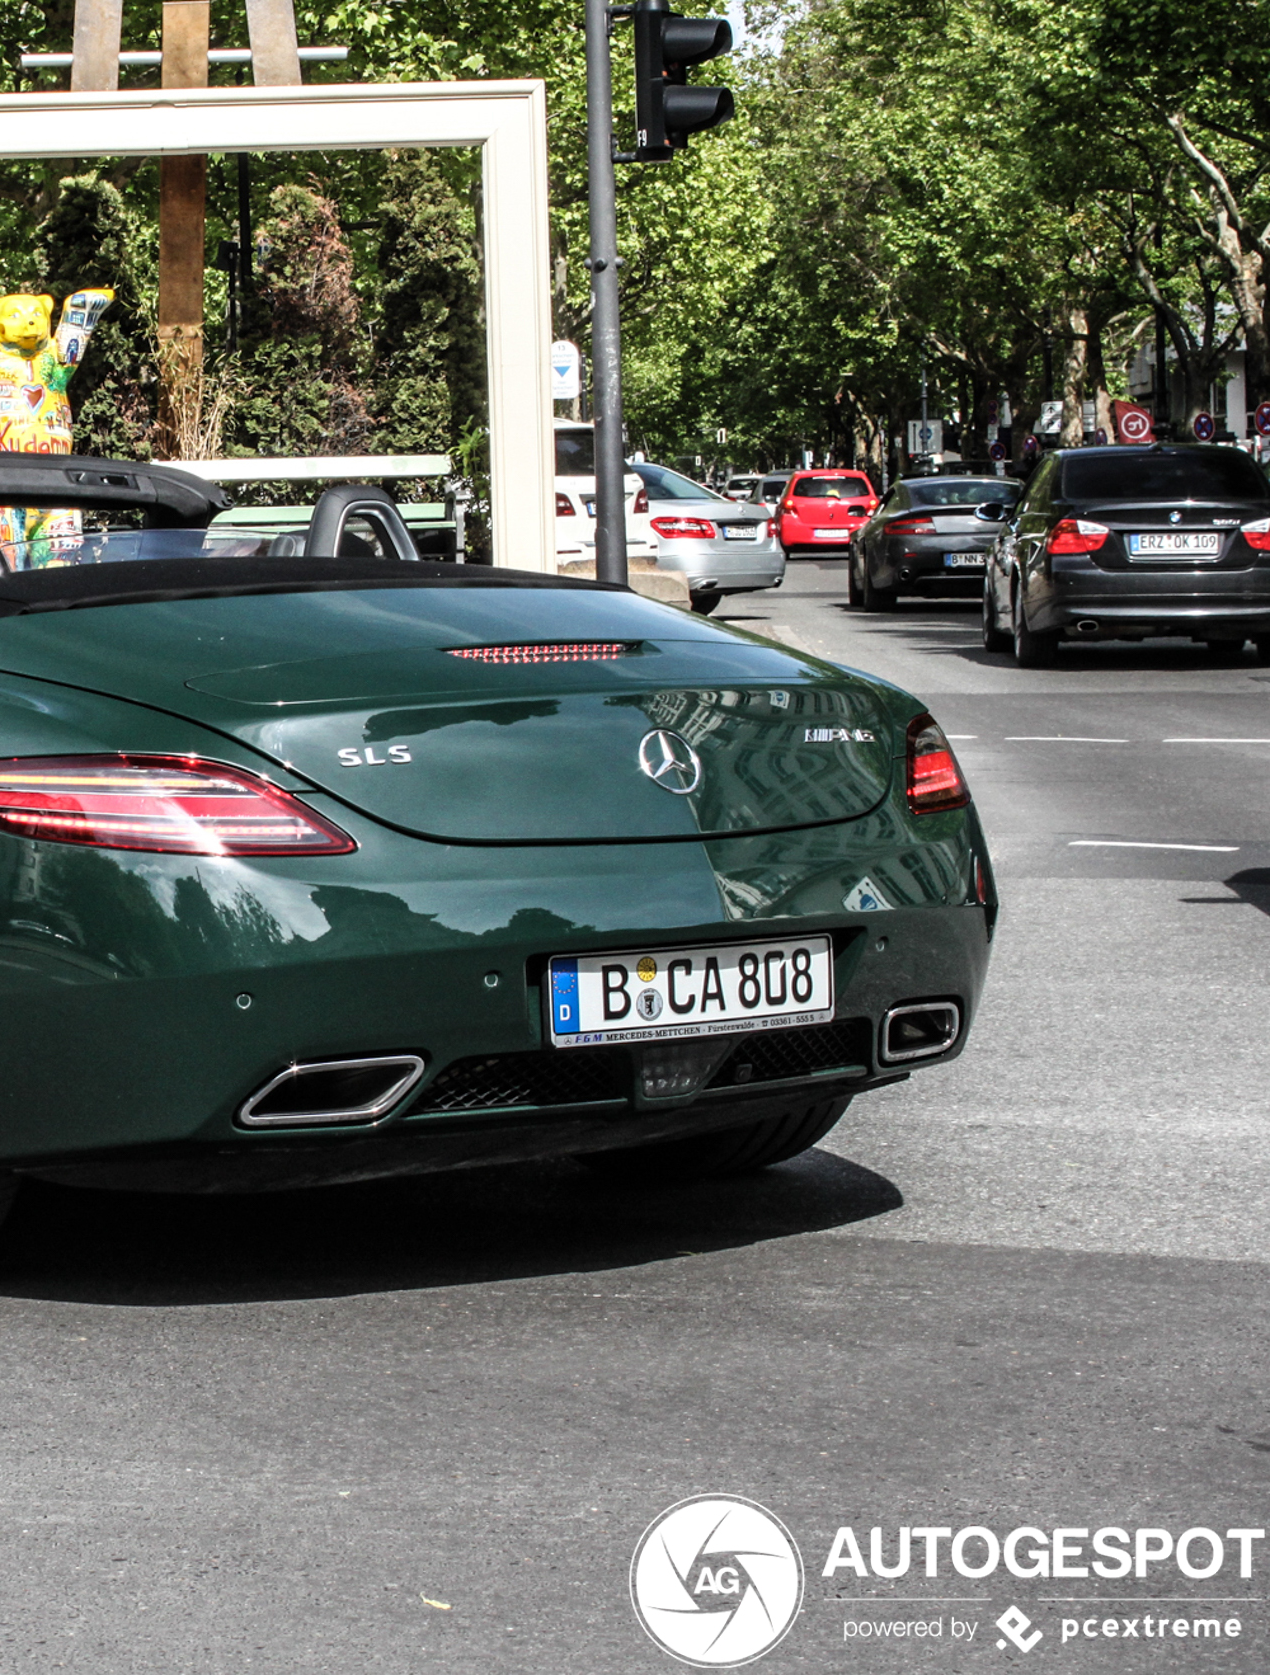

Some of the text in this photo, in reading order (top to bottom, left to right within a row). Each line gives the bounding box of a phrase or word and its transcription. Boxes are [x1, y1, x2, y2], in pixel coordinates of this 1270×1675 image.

[637, 129, 647, 147] F9
[1140, 534, 1217, 549] ERZ OK 109
[952, 554, 959, 564] B
[964, 554, 978, 563] NN
[337, 744, 412, 768] SLS
[601, 947, 813, 1022] B CA 808
[559, 1004, 571, 1022] D
[606, 1026, 701, 1042] MERCEDES-METTCHEN
